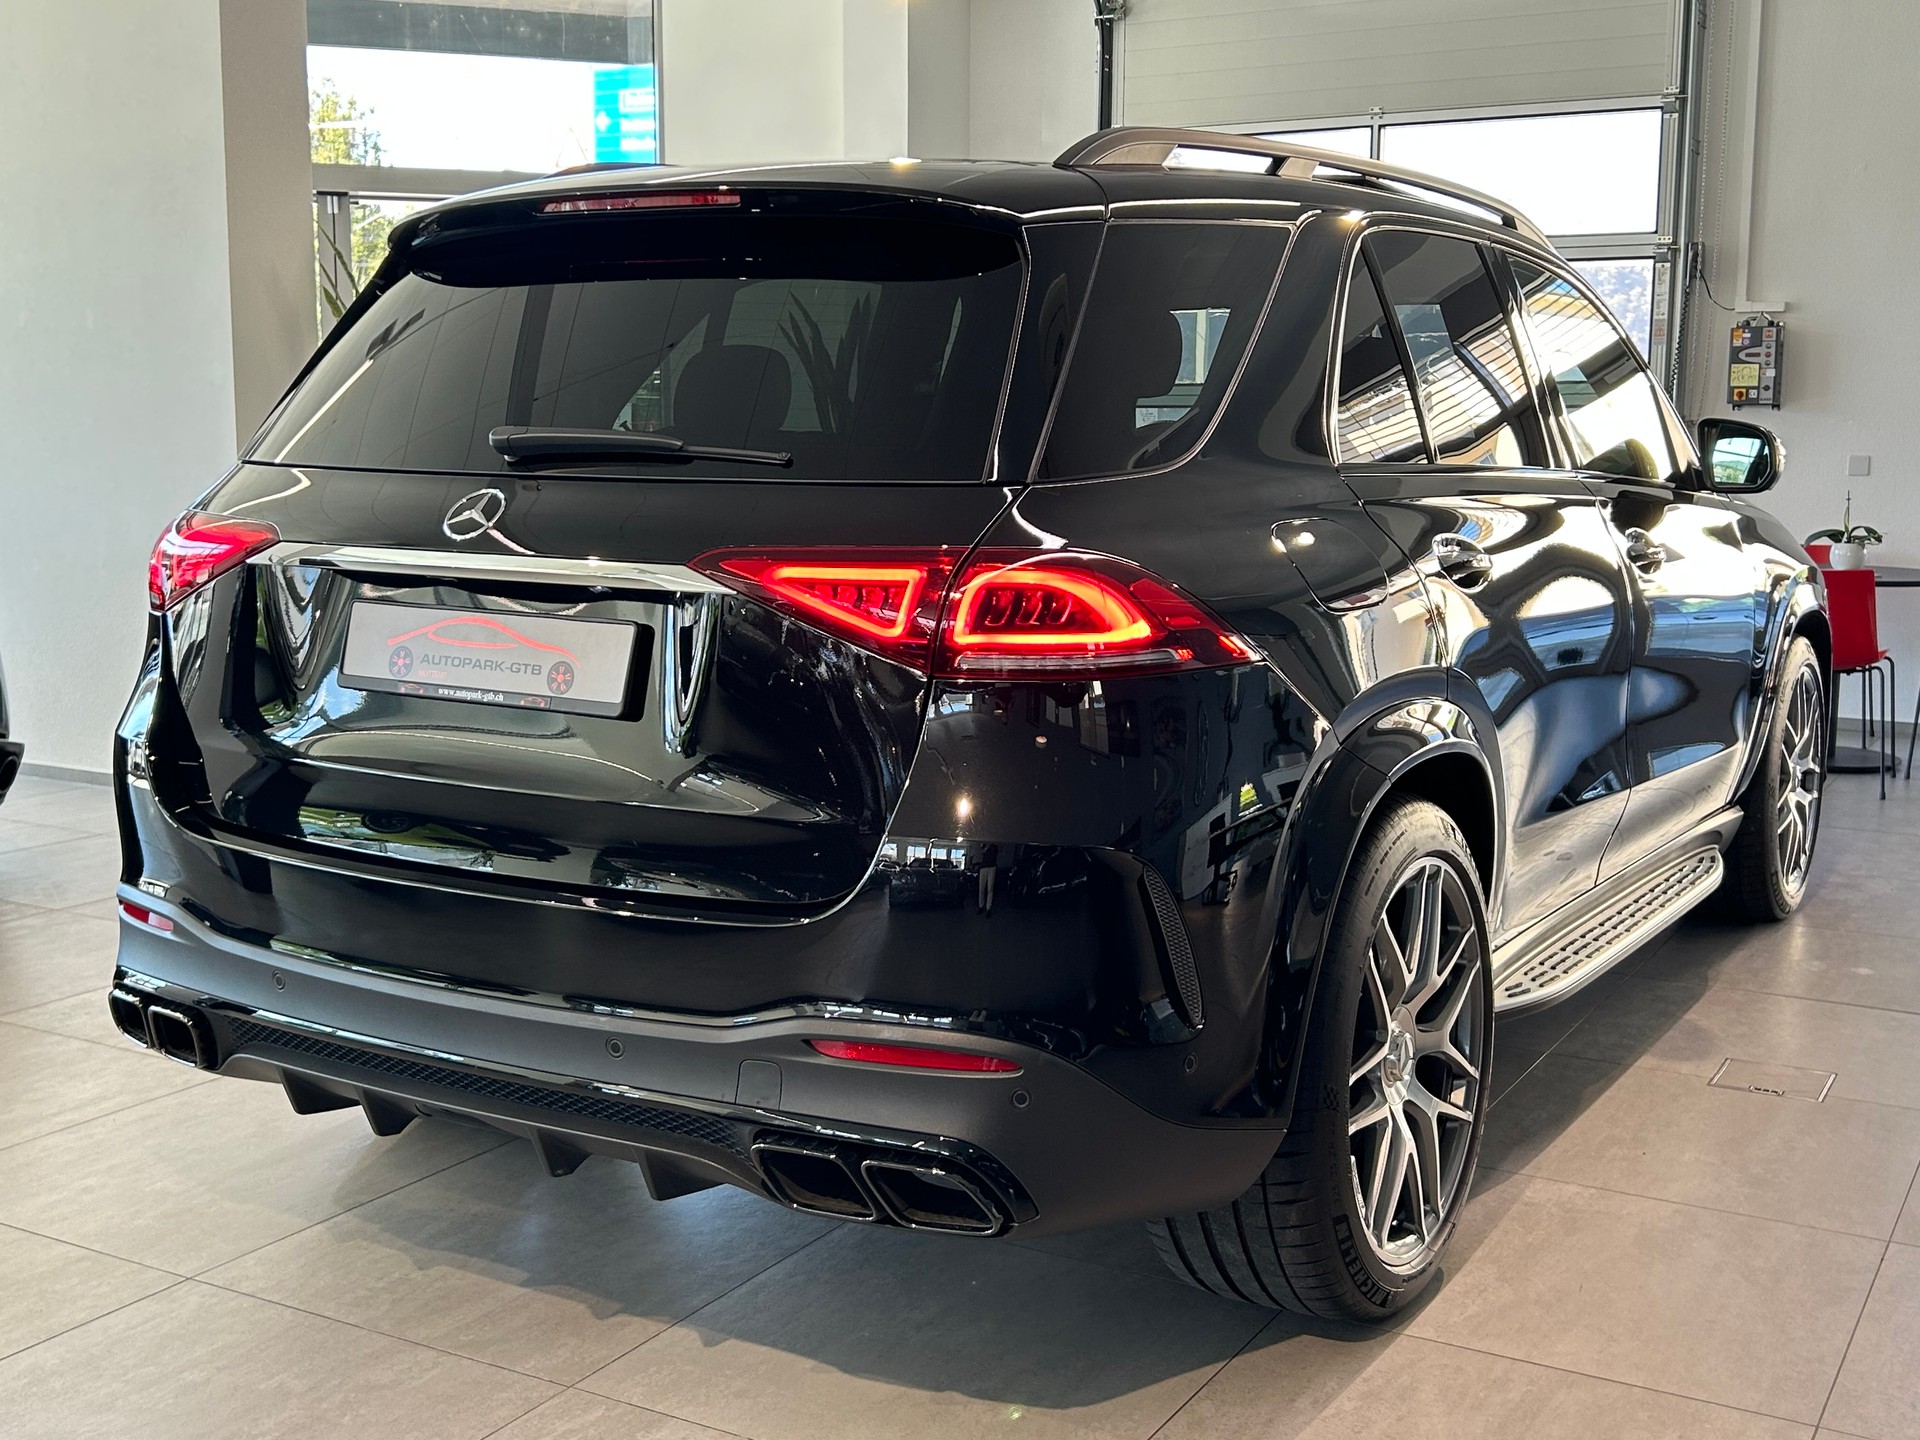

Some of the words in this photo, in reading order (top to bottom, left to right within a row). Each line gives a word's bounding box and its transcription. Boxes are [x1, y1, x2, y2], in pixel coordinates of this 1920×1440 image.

[420, 653, 542, 675] AUTOPARK-GTB
[438, 687, 504, 702] www.autopark-gtb.ch
[1334, 1222, 1388, 1306] MICHELIN
